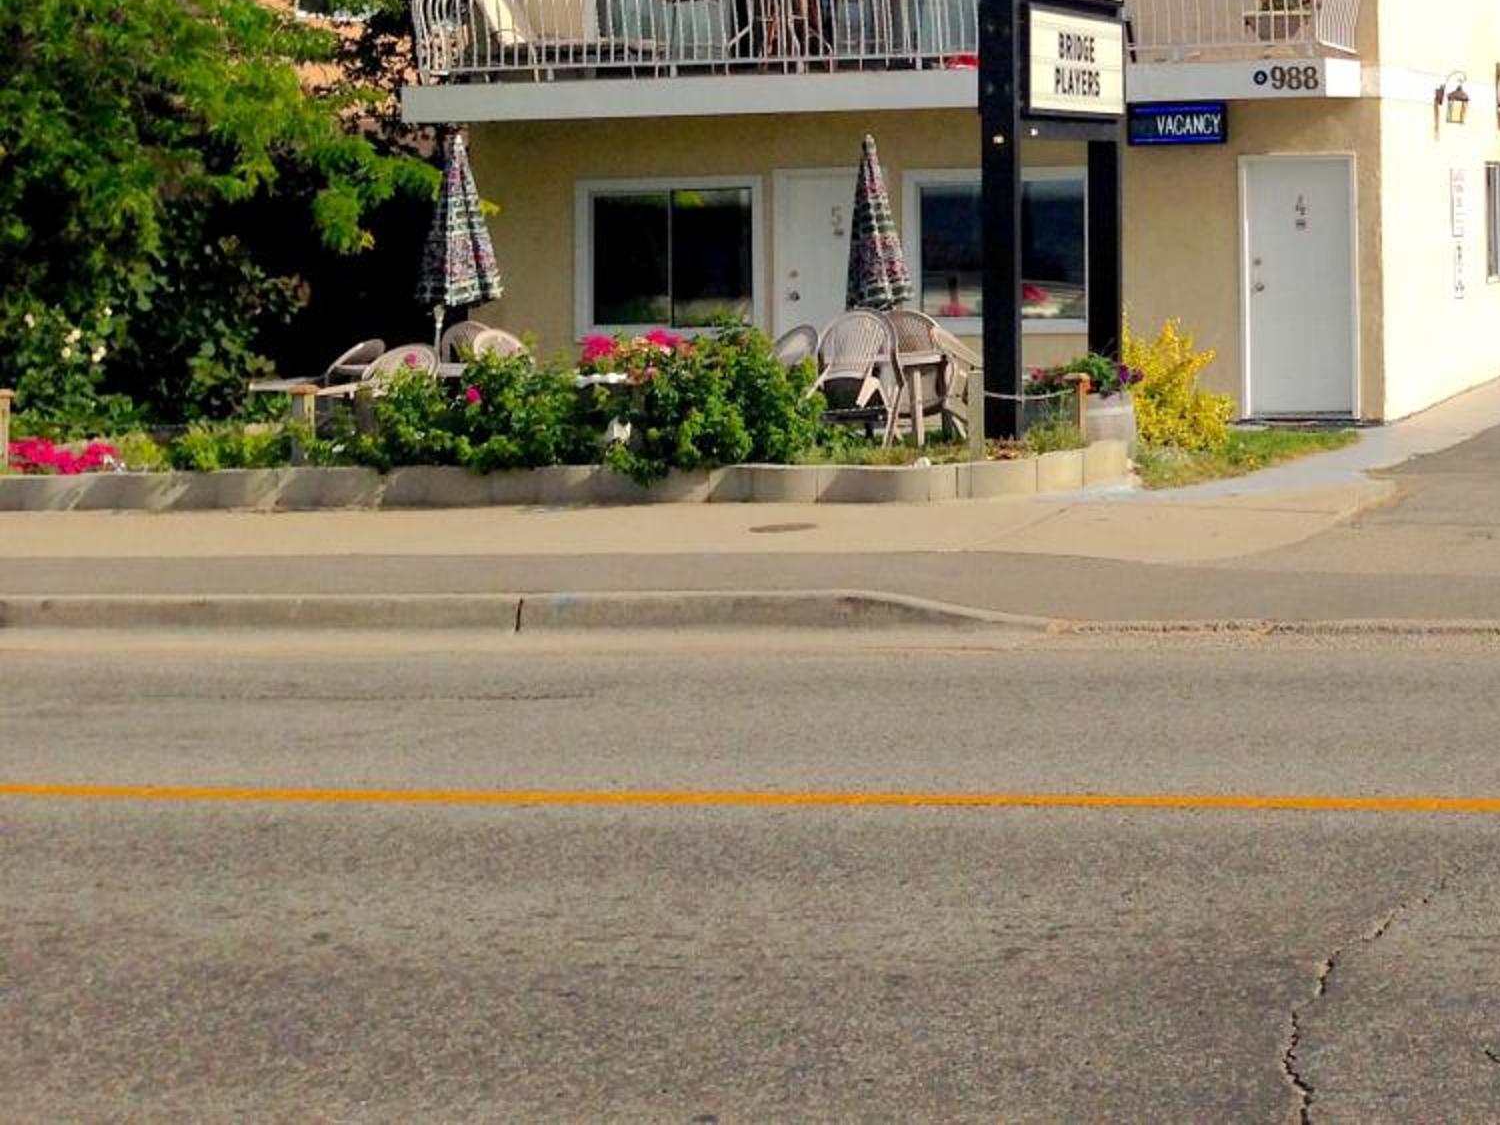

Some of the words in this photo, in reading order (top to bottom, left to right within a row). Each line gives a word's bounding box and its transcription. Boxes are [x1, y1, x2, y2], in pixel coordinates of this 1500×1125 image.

[1058, 32, 1096, 63] BRIDGE
[1055, 68, 1101, 97] PLAYERS
[1270, 66, 1319, 91] 988
[1157, 113, 1222, 136] VACANCY
